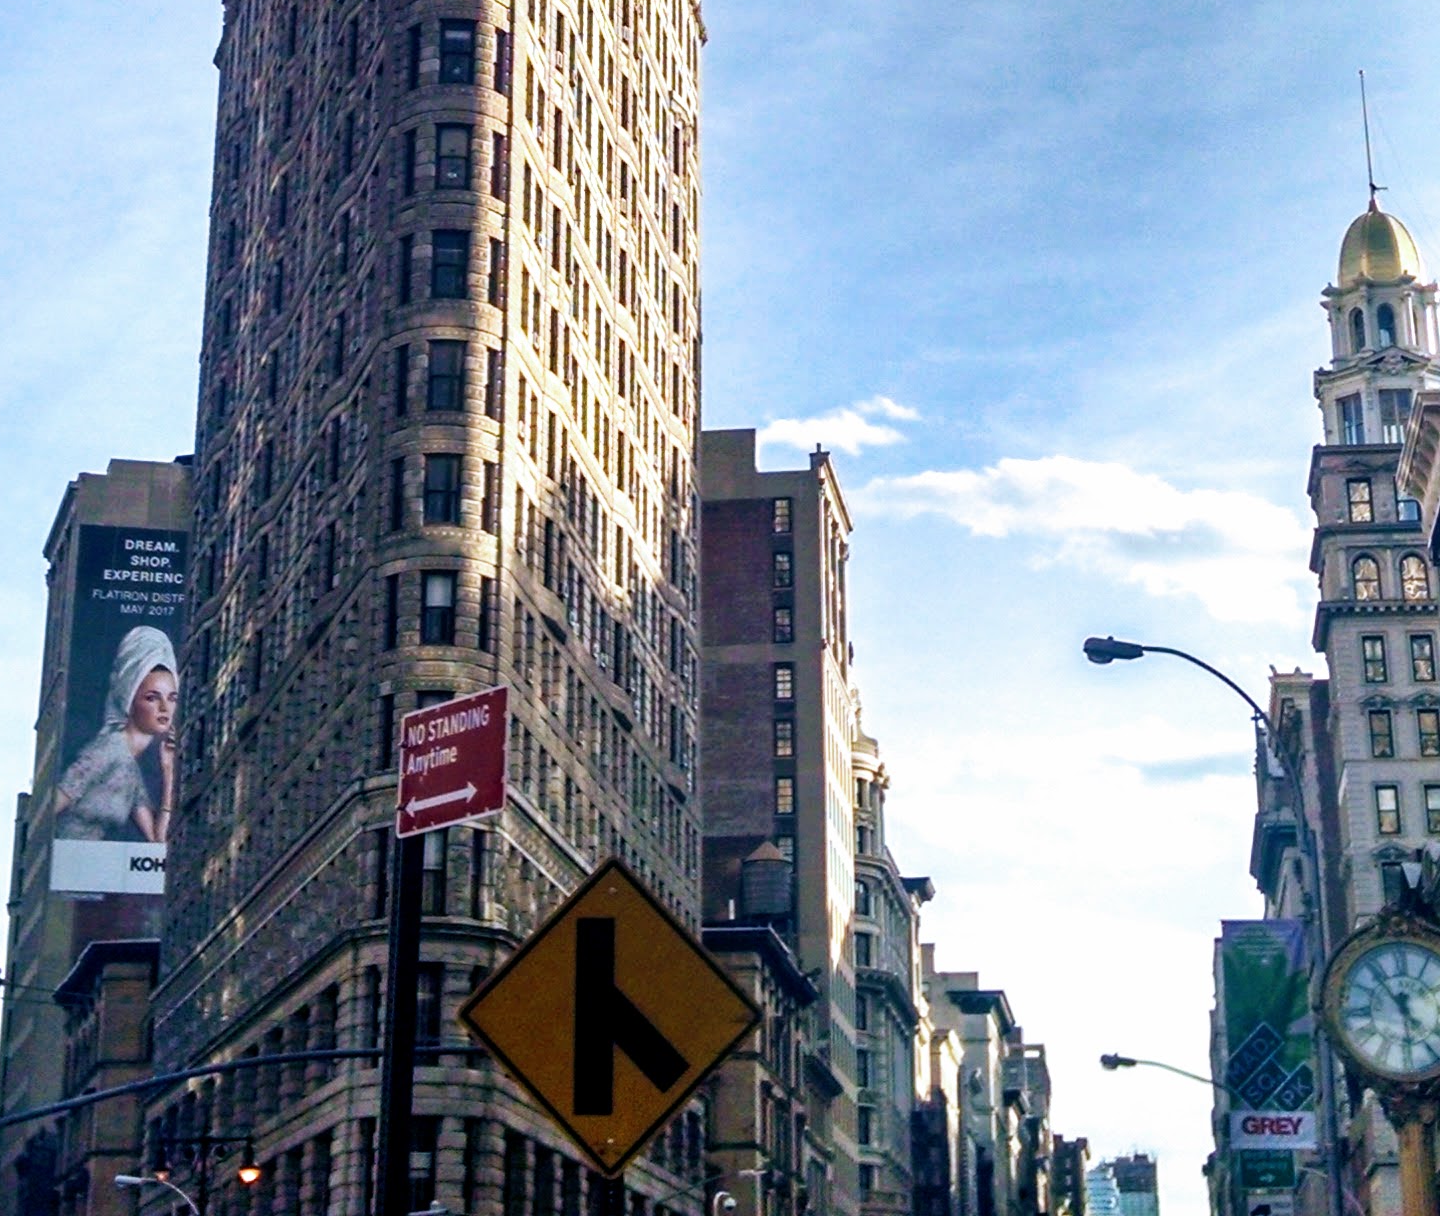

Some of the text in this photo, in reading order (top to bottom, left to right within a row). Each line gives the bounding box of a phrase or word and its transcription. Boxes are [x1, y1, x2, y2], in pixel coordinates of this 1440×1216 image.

[124, 539, 180, 553] DREAM.
[130, 555, 172, 568] SHOP.
[103, 569, 184, 583] EXPERIENC
[92, 588, 149, 602] FLATIRON
[120, 604, 175, 616] MAY 2017
[408, 704, 490, 747] NO STANDING
[407, 746, 458, 776] Anytime
[130, 856, 166, 872] KOH
[1227, 1038, 1276, 1082] MAD.
[1282, 1076, 1311, 1107] PK
[1242, 1115, 1303, 1135] GREY
